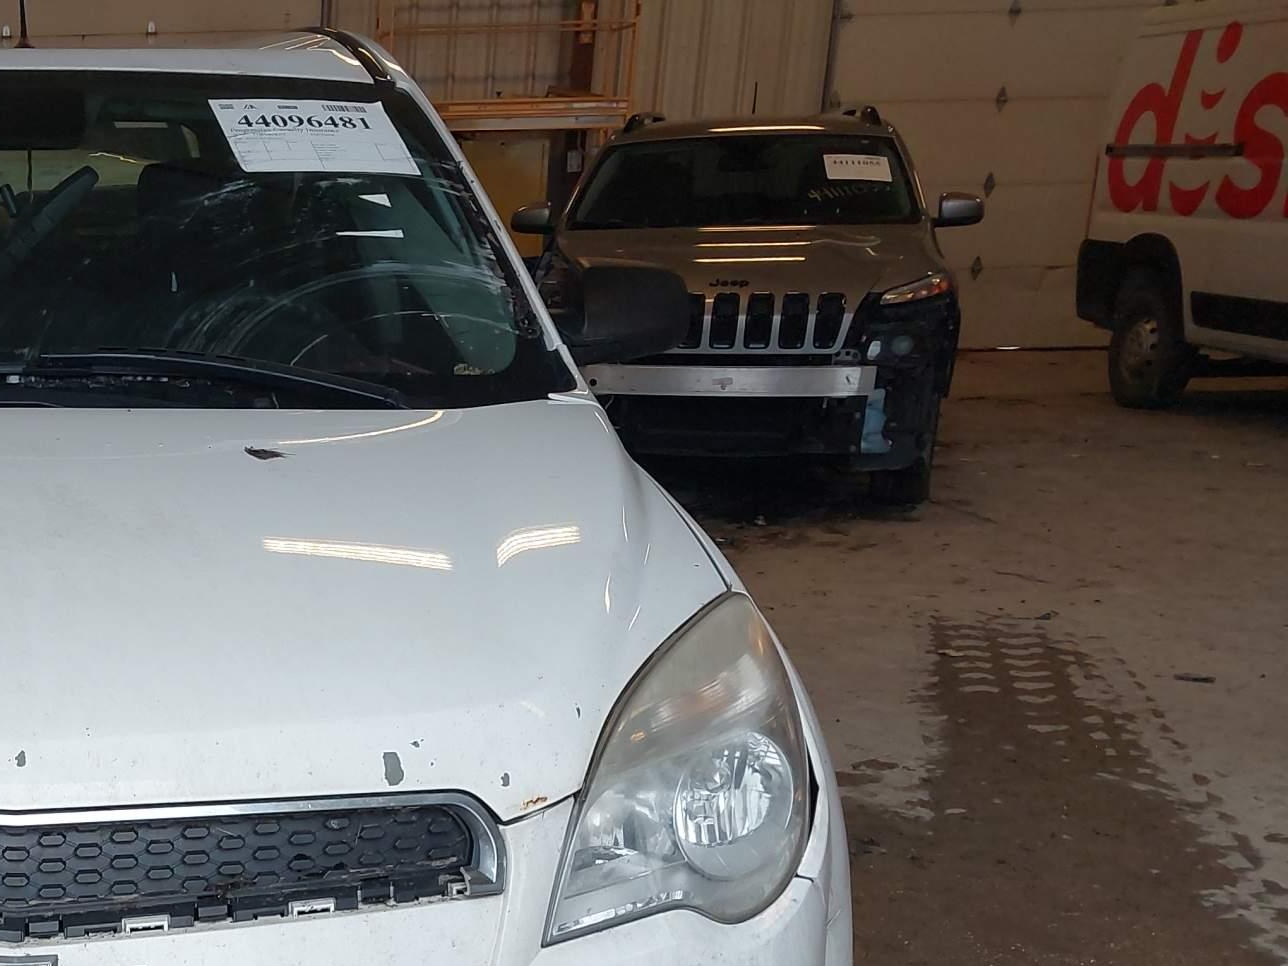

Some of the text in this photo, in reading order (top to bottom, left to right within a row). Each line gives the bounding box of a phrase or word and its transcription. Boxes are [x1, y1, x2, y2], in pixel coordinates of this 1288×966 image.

[237, 114, 372, 130] 44096481
[1107, 20, 1288, 219] dis
[708, 277, 750, 288] Jeep
